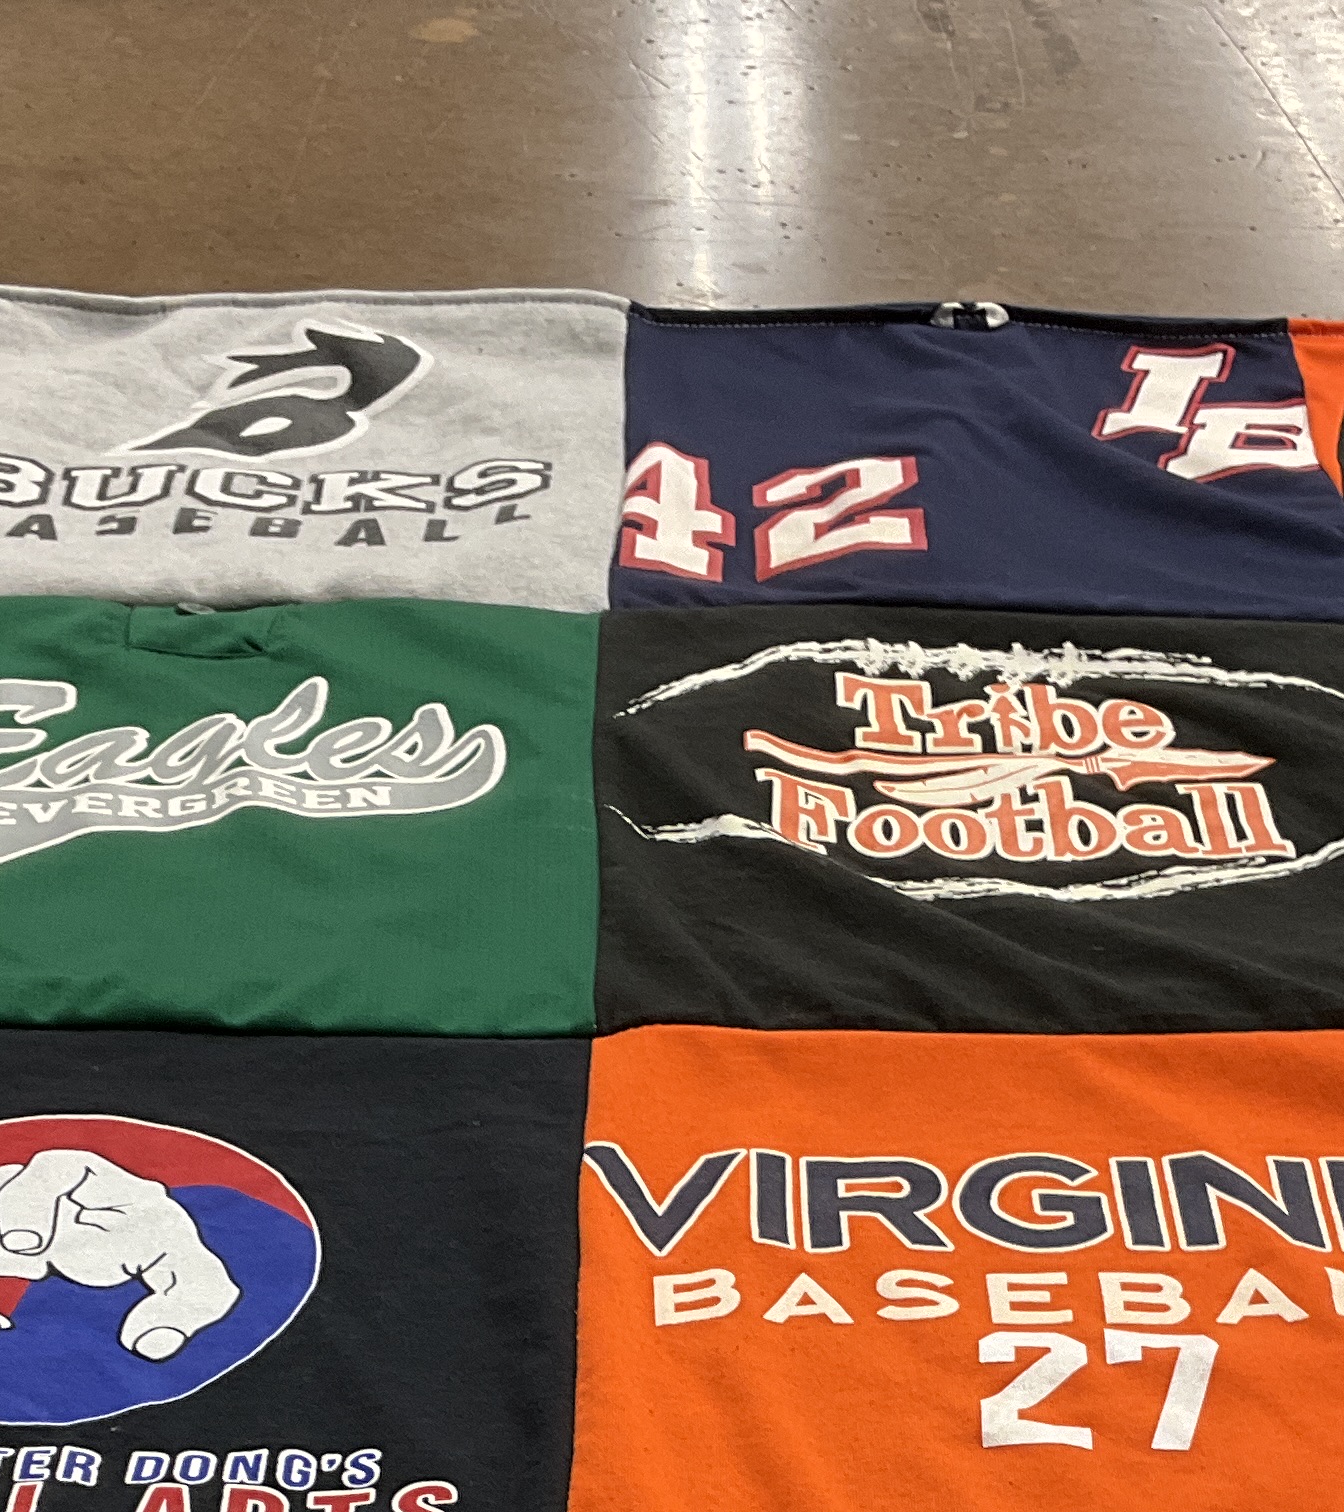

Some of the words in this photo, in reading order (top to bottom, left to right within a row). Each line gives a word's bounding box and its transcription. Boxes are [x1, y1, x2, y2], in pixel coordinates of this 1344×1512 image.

[619, 441, 928, 582] 42
[836, 672, 1175, 756] Tribe
[755, 767, 1297, 862] Football
[978, 1328, 1218, 1451] 27
[126, 1448, 384, 1490] DONG'S
